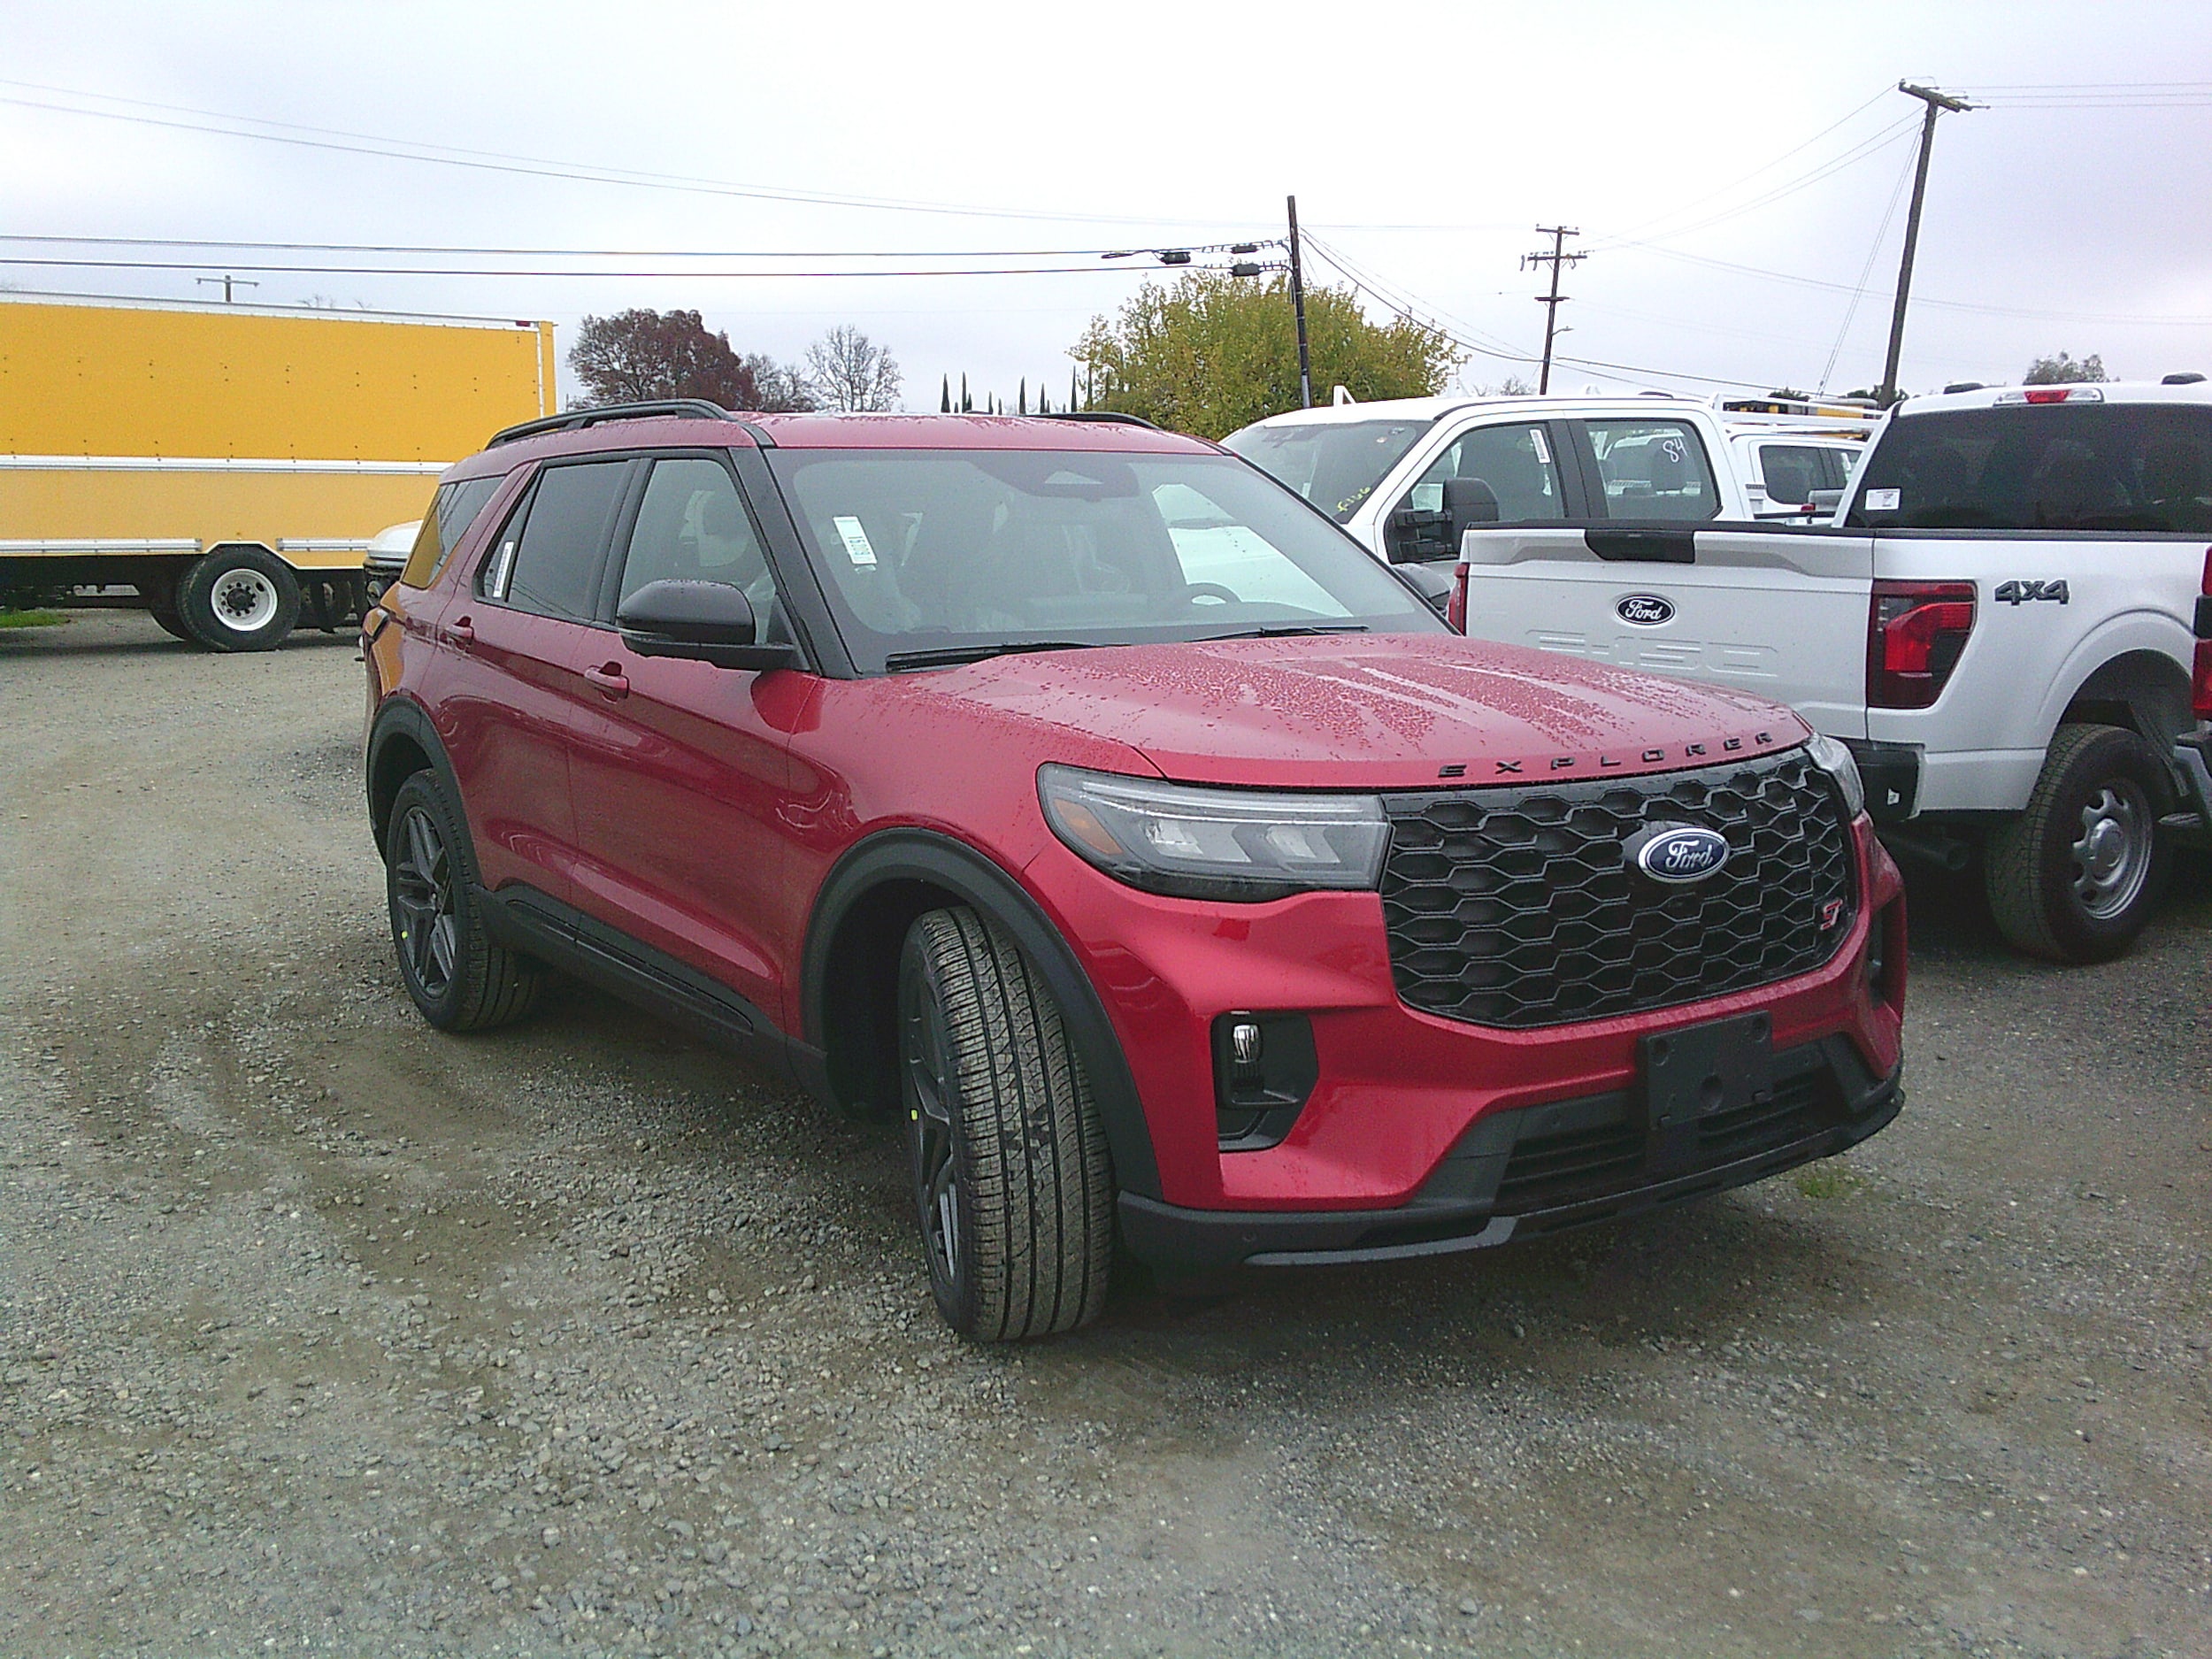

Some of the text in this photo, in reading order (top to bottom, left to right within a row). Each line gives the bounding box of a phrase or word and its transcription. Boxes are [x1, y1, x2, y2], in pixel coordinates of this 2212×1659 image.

[1663, 437, 1688, 463] 84
[1438, 732, 1773, 777] EXPLORER
[1820, 899, 1843, 931] ST
